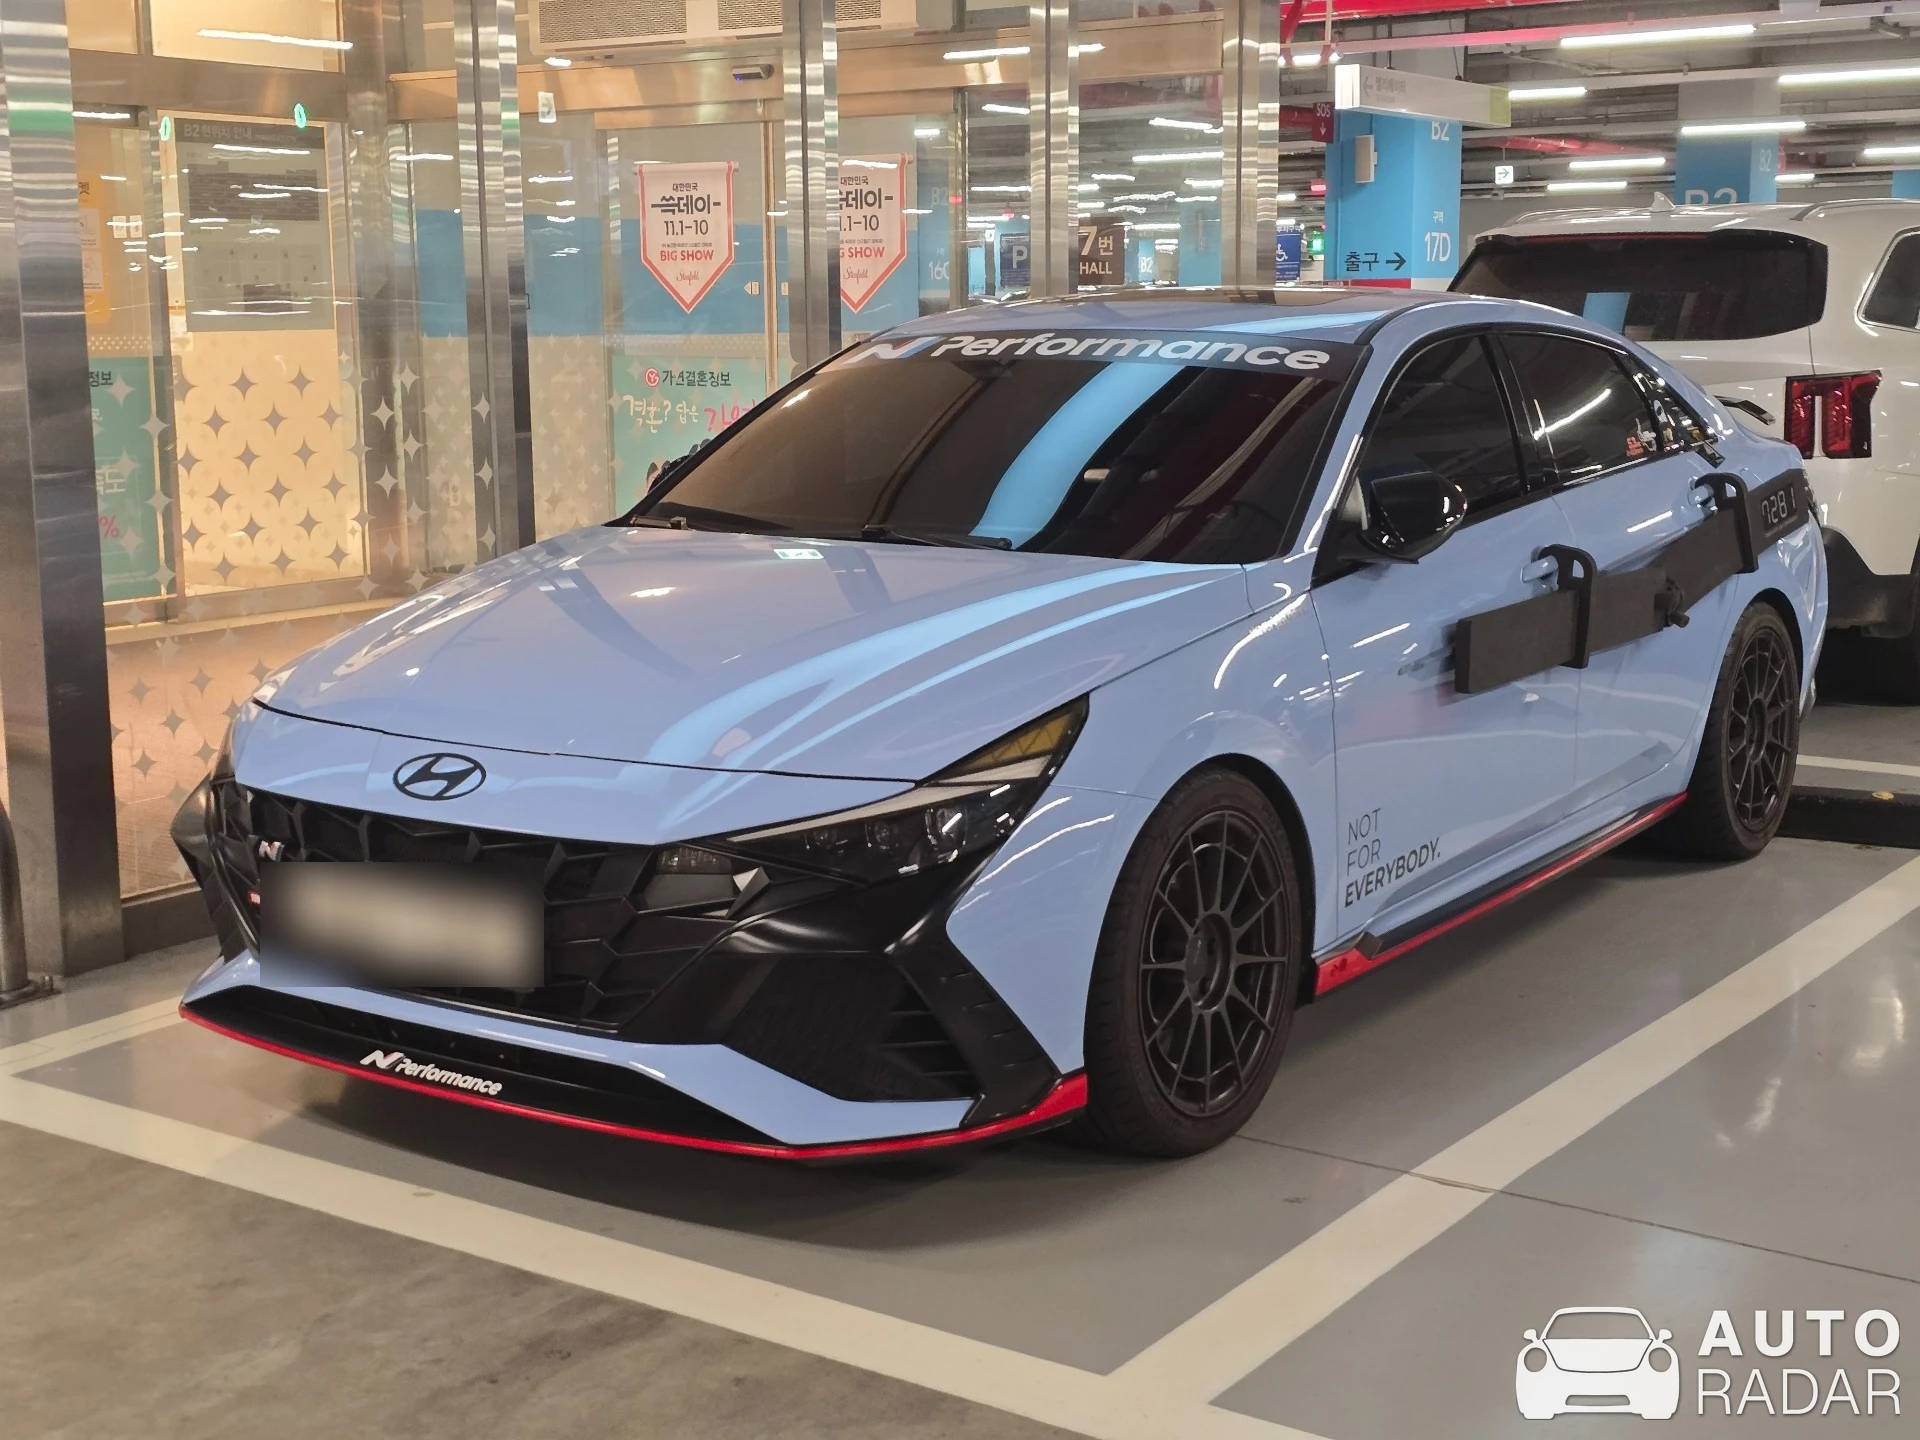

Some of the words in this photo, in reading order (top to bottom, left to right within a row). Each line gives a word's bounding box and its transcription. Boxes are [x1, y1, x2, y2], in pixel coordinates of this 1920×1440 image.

[1316, 103, 1331, 118] SOS
[184, 123, 200, 137] B2
[1760, 149, 1772, 172] B2
[672, 182, 699, 192] 대한민국
[840, 175, 869, 186] 대한민국
[663, 219, 709, 236] 11.1-10
[660, 250, 678, 261] BIG
[680, 249, 714, 261] SHOW
[847, 246, 885, 258] SHOW
[1424, 231, 1451, 262] 17D
[1079, 262, 1113, 275] HALL
[1140, 256, 1154, 273] B2
[1344, 251, 1380, 272] 출구
[931, 332, 1331, 370] Performance
[1348, 807, 1381, 846] NOT
[1347, 838, 1381, 877] FOR
[1344, 836, 1440, 908] EVERYBODY.
[395, 1058, 503, 1096] Performance
